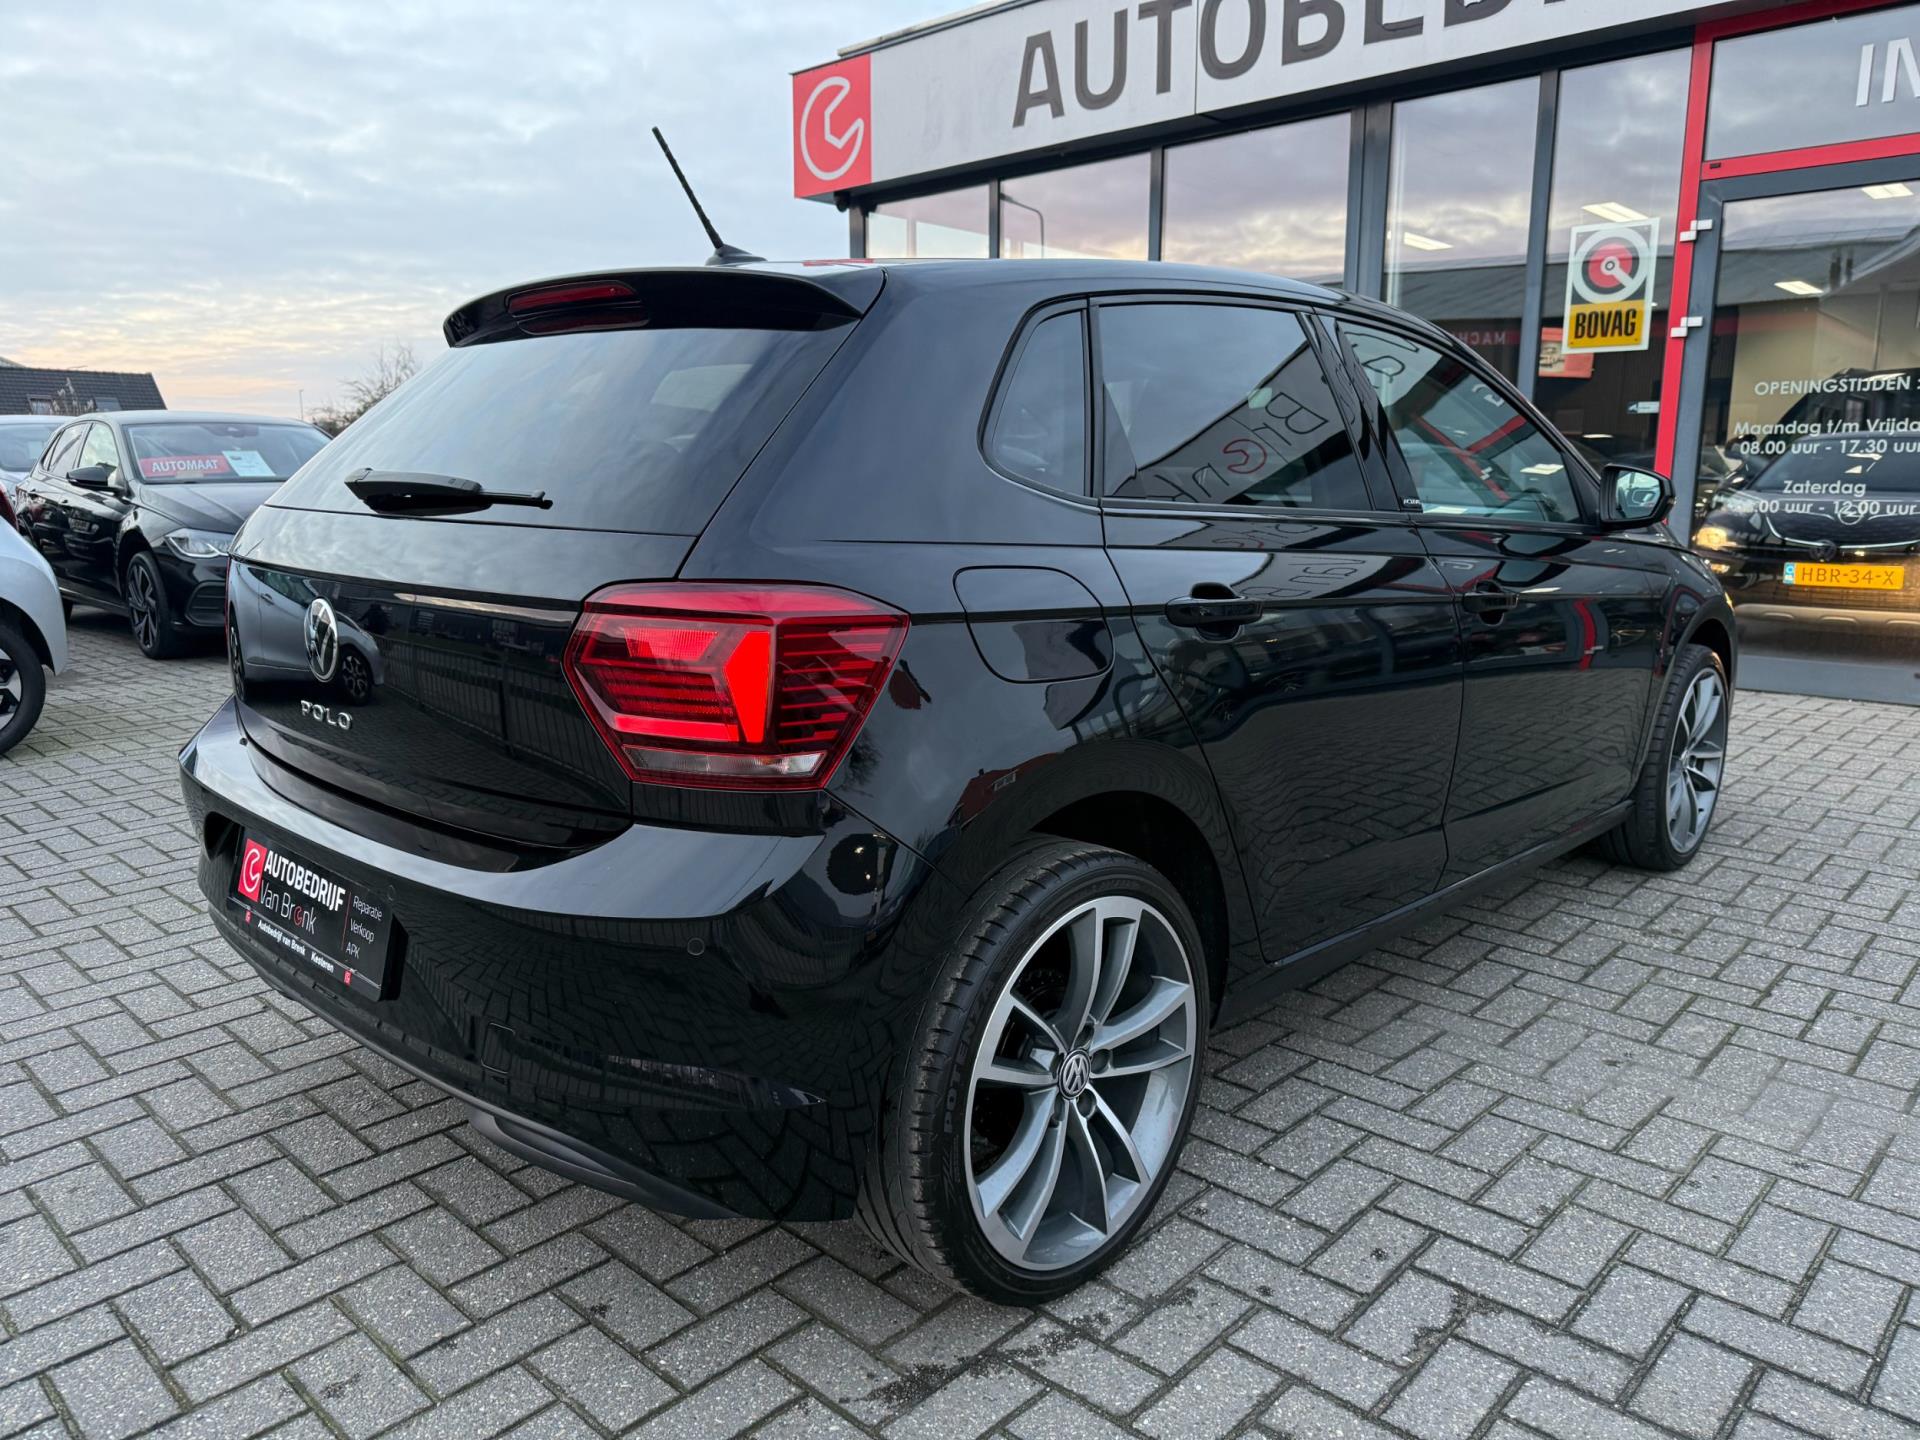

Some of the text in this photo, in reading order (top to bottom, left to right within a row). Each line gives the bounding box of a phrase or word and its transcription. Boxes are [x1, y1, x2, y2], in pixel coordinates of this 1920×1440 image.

[1012, 0, 1568, 128] AUTOB
[1573, 308, 1637, 339] BOVAG
[1754, 376, 1911, 396] OPENINGSTIJDEN
[1733, 417, 1920, 437] Maandag t/m Vrijda
[1740, 440, 1786, 455] 08.00
[1791, 442, 1820, 454] uur
[1839, 439, 1888, 454] 17.30
[152, 459, 219, 473] AUTOMAAT
[1783, 480, 1867, 498] Zaterdag
[1784, 502, 1813, 514] uur
[1886, 503, 1918, 515] uur
[1801, 567, 1895, 585] HBR-34-X
[301, 700, 353, 730] POLO
[264, 850, 346, 911] AUTOBEDRIJF
[260, 880, 280, 912] Van
[352, 896, 384, 922] Reparatie
[257, 919, 283, 943] Autobedrijf
[350, 918, 375, 945] Verkoop
[346, 942, 360, 959] APK
